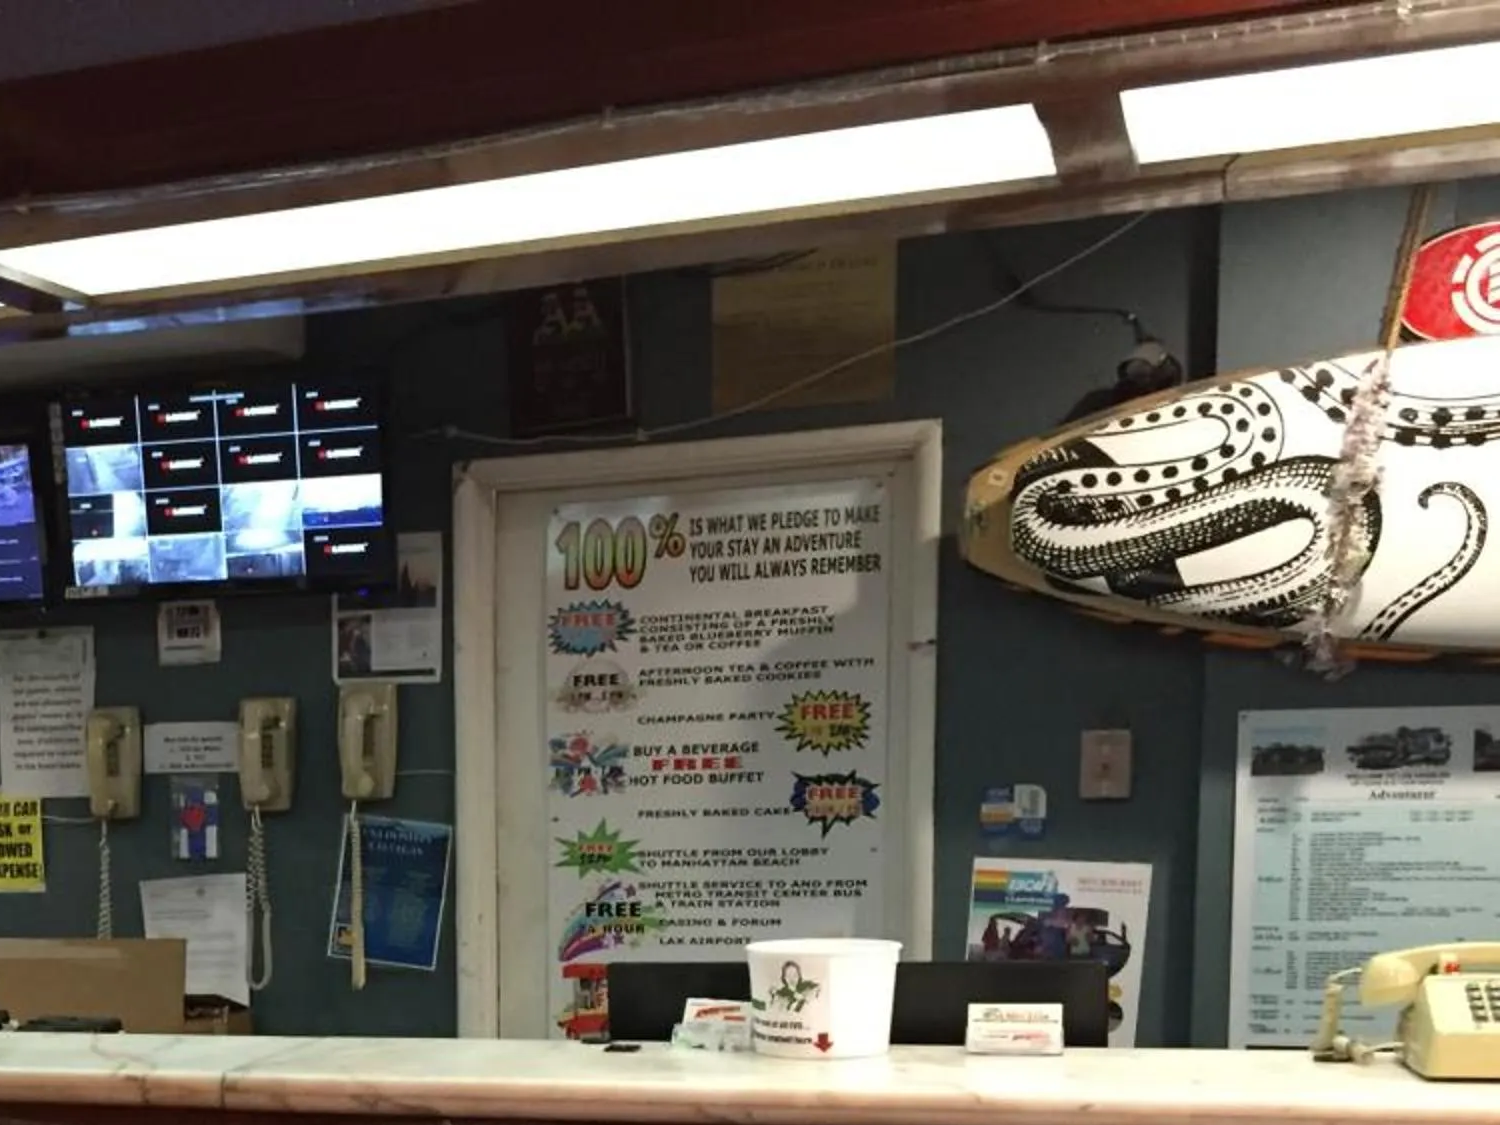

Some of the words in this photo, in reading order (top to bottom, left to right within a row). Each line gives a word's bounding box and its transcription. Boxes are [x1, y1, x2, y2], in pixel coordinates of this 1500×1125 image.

[690, 517, 703, 536] IS
[707, 514, 744, 534] WHAT
[748, 513, 767, 531] WE
[771, 509, 820, 530] PLEDGE
[824, 508, 841, 526] TO
[845, 504, 881, 524] MAKE
[555, 512, 687, 591] 100%
[690, 541, 724, 560] YOUR
[727, 537, 760, 558] STAY
[763, 536, 781, 554] AN
[784, 530, 862, 553] ADVENTURE
[690, 565, 715, 583] YOU
[719, 563, 751, 581] WILL
[755, 559, 807, 579] ALWAYS
[811, 553, 882, 575] REMEMBER
[639, 611, 738, 625] CONTINENTAL
[744, 605, 829, 619] BREAKFAST
[639, 622, 730, 635] CONSISTING
[733, 620, 752, 631] OF
[771, 615, 835, 628] FRESHLY
[639, 634, 685, 645] BAKED
[689, 628, 773, 642] BLUEBERRY
[777, 625, 835, 637] MUFFIN
[655, 643, 680, 653] TEA
[684, 641, 704, 652] OR
[707, 638, 762, 650] COFFEE
[639, 665, 724, 678] AFTERNOON
[729, 663, 755, 673] TEA
[774, 659, 829, 671] COFFEE
[833, 657, 875, 668] WITH
[573, 674, 620, 687] FREE
[639, 676, 700, 688] FRESHLY
[705, 674, 752, 685] BAKED
[756, 670, 822, 682] COOKIES
[637, 712, 725, 725] CHAMPAGNE
[729, 711, 775, 722] PARTY
[801, 702, 856, 721] FREE
[633, 744, 663, 757] BUY
[667, 744, 678, 756] A
[682, 741, 760, 755] BEVERAGE
[652, 756, 742, 771] FREE
[629, 774, 658, 787] HOT
[663, 773, 704, 785] FOOD
[709, 772, 765, 784] BUFFET
[807, 786, 860, 799] FREE
[13, 801, 38, 817] CAR
[637, 809, 698, 819] FRESHLY
[703, 808, 750, 818] BAKED
[754, 807, 791, 817] CAKE
[637, 849, 699, 860] SHUTTLE
[703, 849, 744, 858] FROM
[747, 847, 778, 858] OUR
[781, 846, 830, 857] LOBBY
[639, 859, 657, 869] TO
[661, 858, 749, 869] MANHATTAN
[752, 857, 801, 868] BEACH
[638, 880, 699, 891] SHUTTLE
[703, 879, 764, 890] SERVICE
[768, 879, 787, 889] TO
[790, 879, 822, 889] AND
[826, 878, 869, 889] FROM
[655, 889, 703, 899] METRO
[708, 889, 768, 899] TRANSIT
[773, 888, 829, 898] CENTER
[833, 888, 863, 898] BUS
[585, 901, 643, 919] FREE
[670, 899, 714, 909] TRAIN
[718, 899, 781, 909] STATION
[603, 923, 646, 934] HOUR
[659, 918, 714, 928] CASINO
[732, 917, 783, 928] FORUM
[659, 937, 684, 946] LAX
[689, 936, 752, 946] AIRPORT
